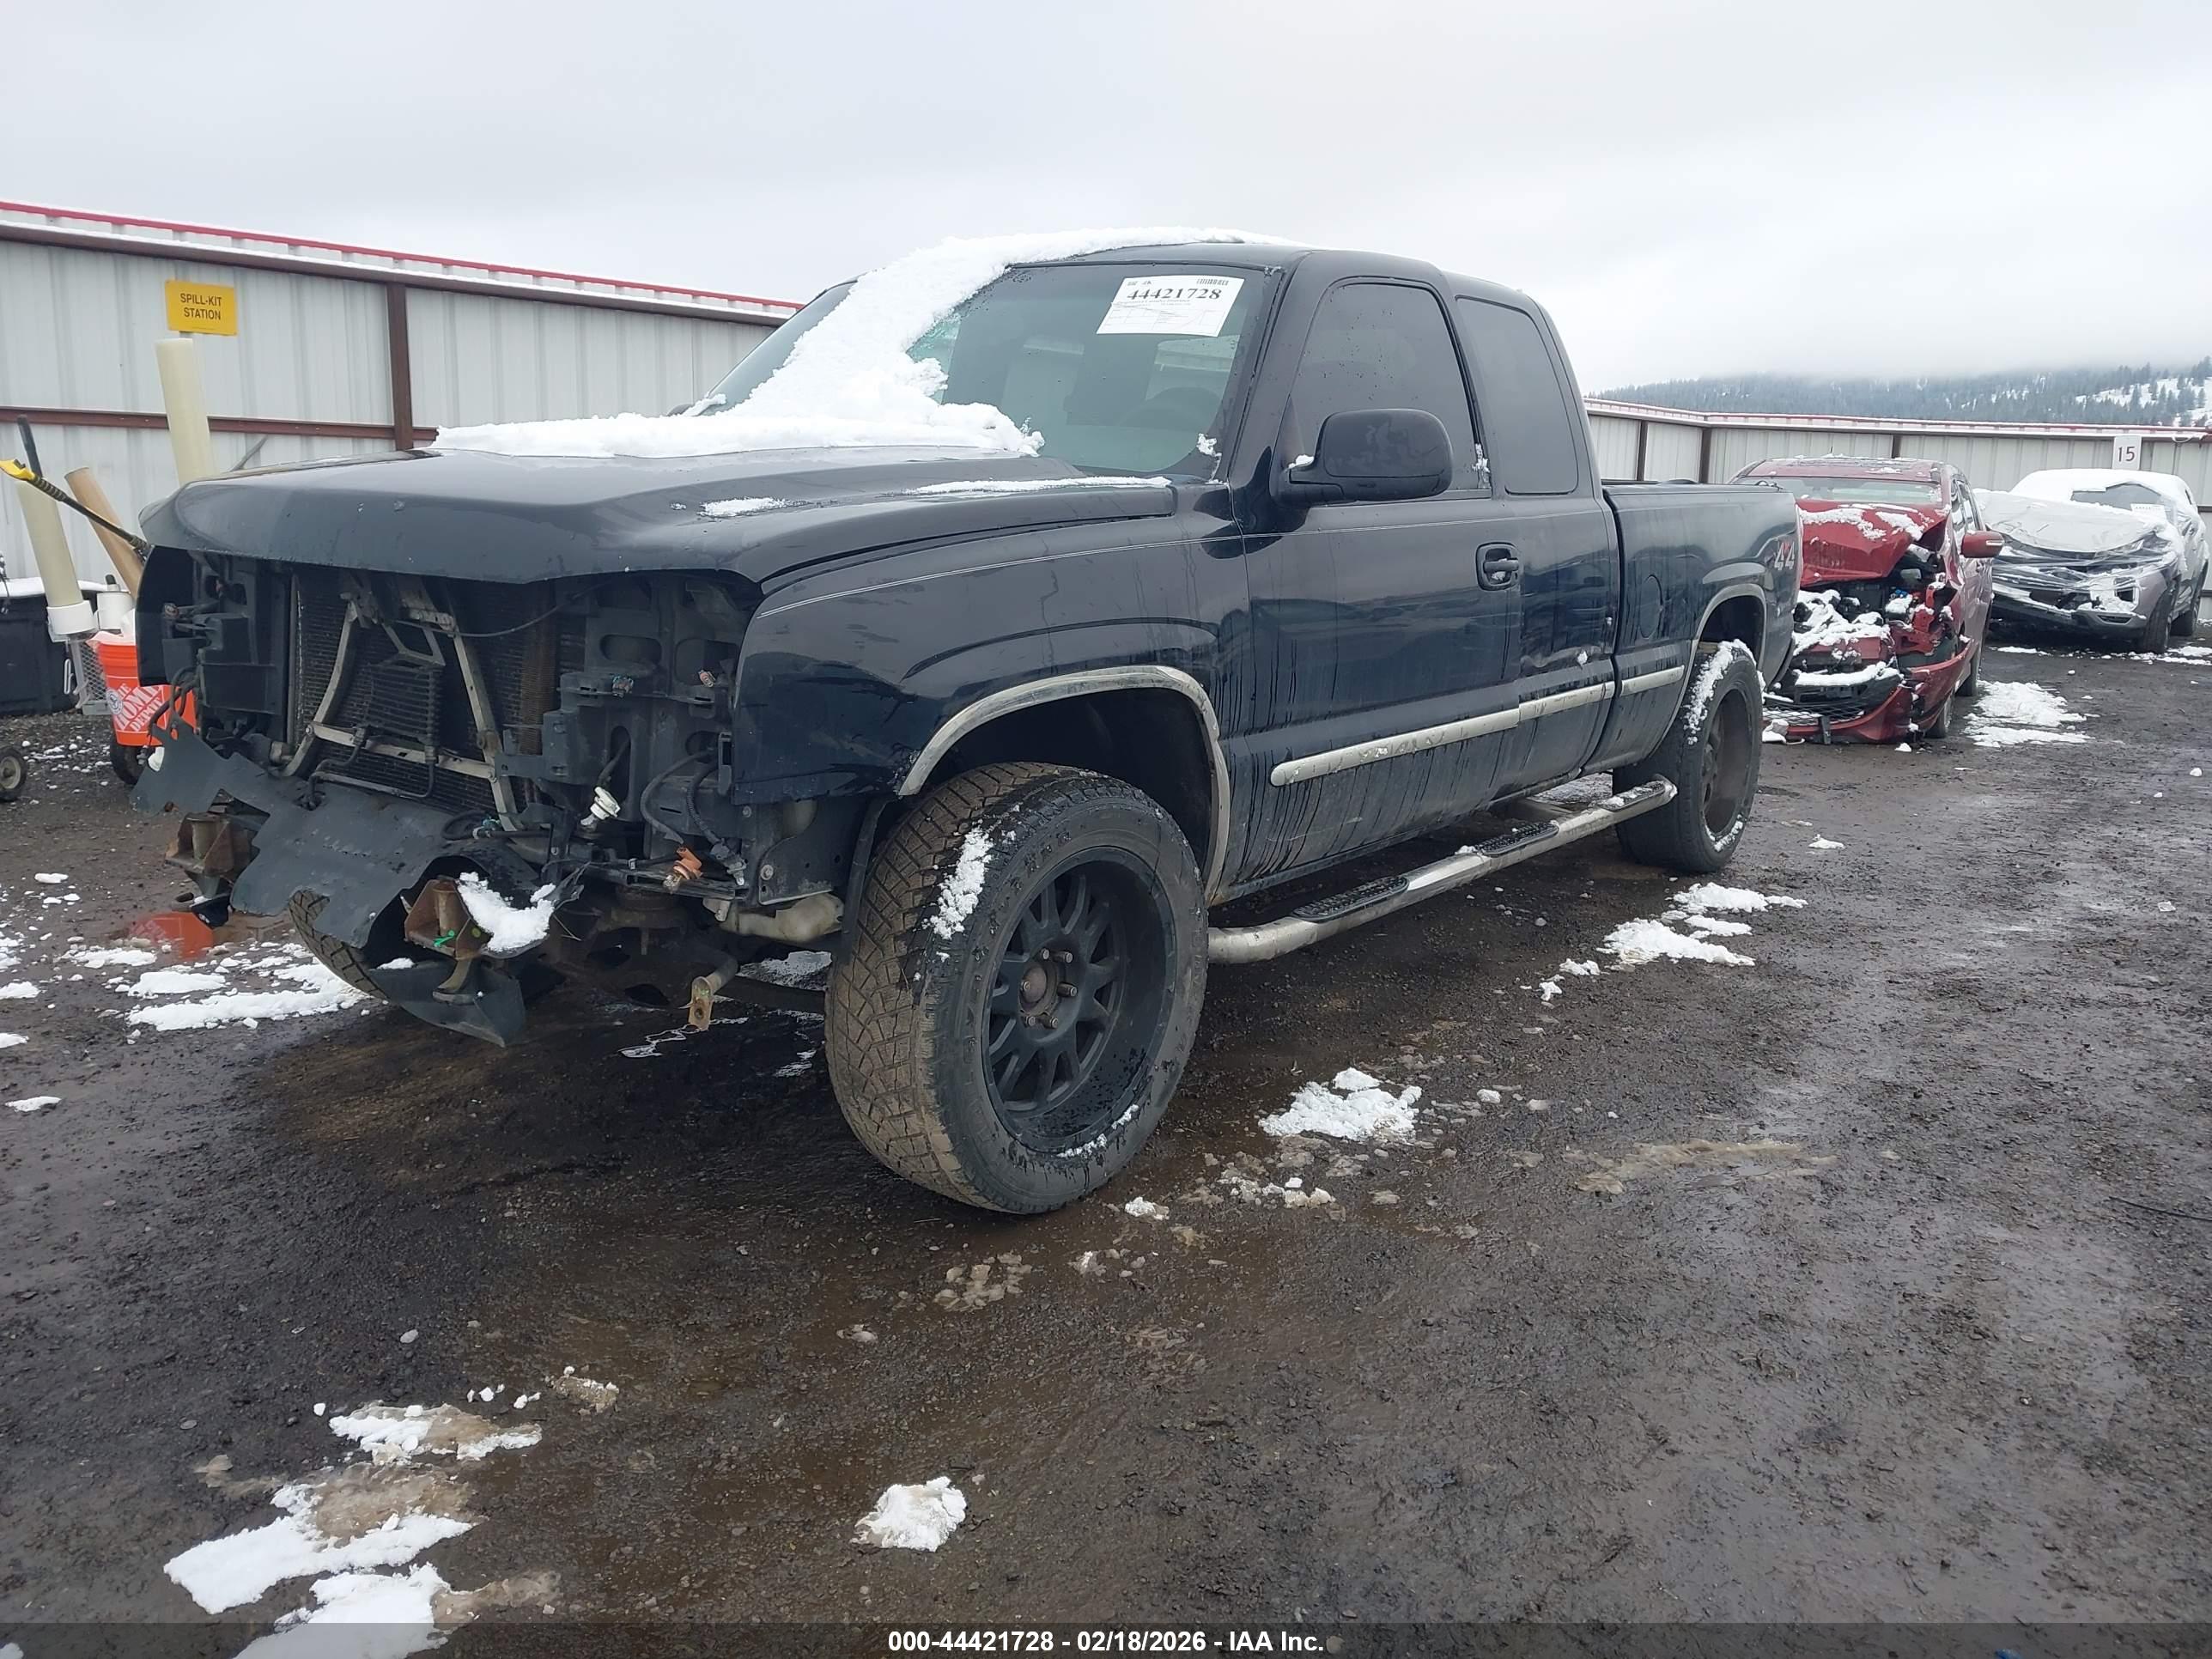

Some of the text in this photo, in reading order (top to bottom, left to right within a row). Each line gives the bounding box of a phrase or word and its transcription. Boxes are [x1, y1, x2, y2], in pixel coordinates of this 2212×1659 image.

[180, 293, 222, 307] SPILL-KIT
[1127, 288, 1223, 301] 44421728
[184, 307, 222, 320] STATION
[2118, 446, 2136, 463] 15
